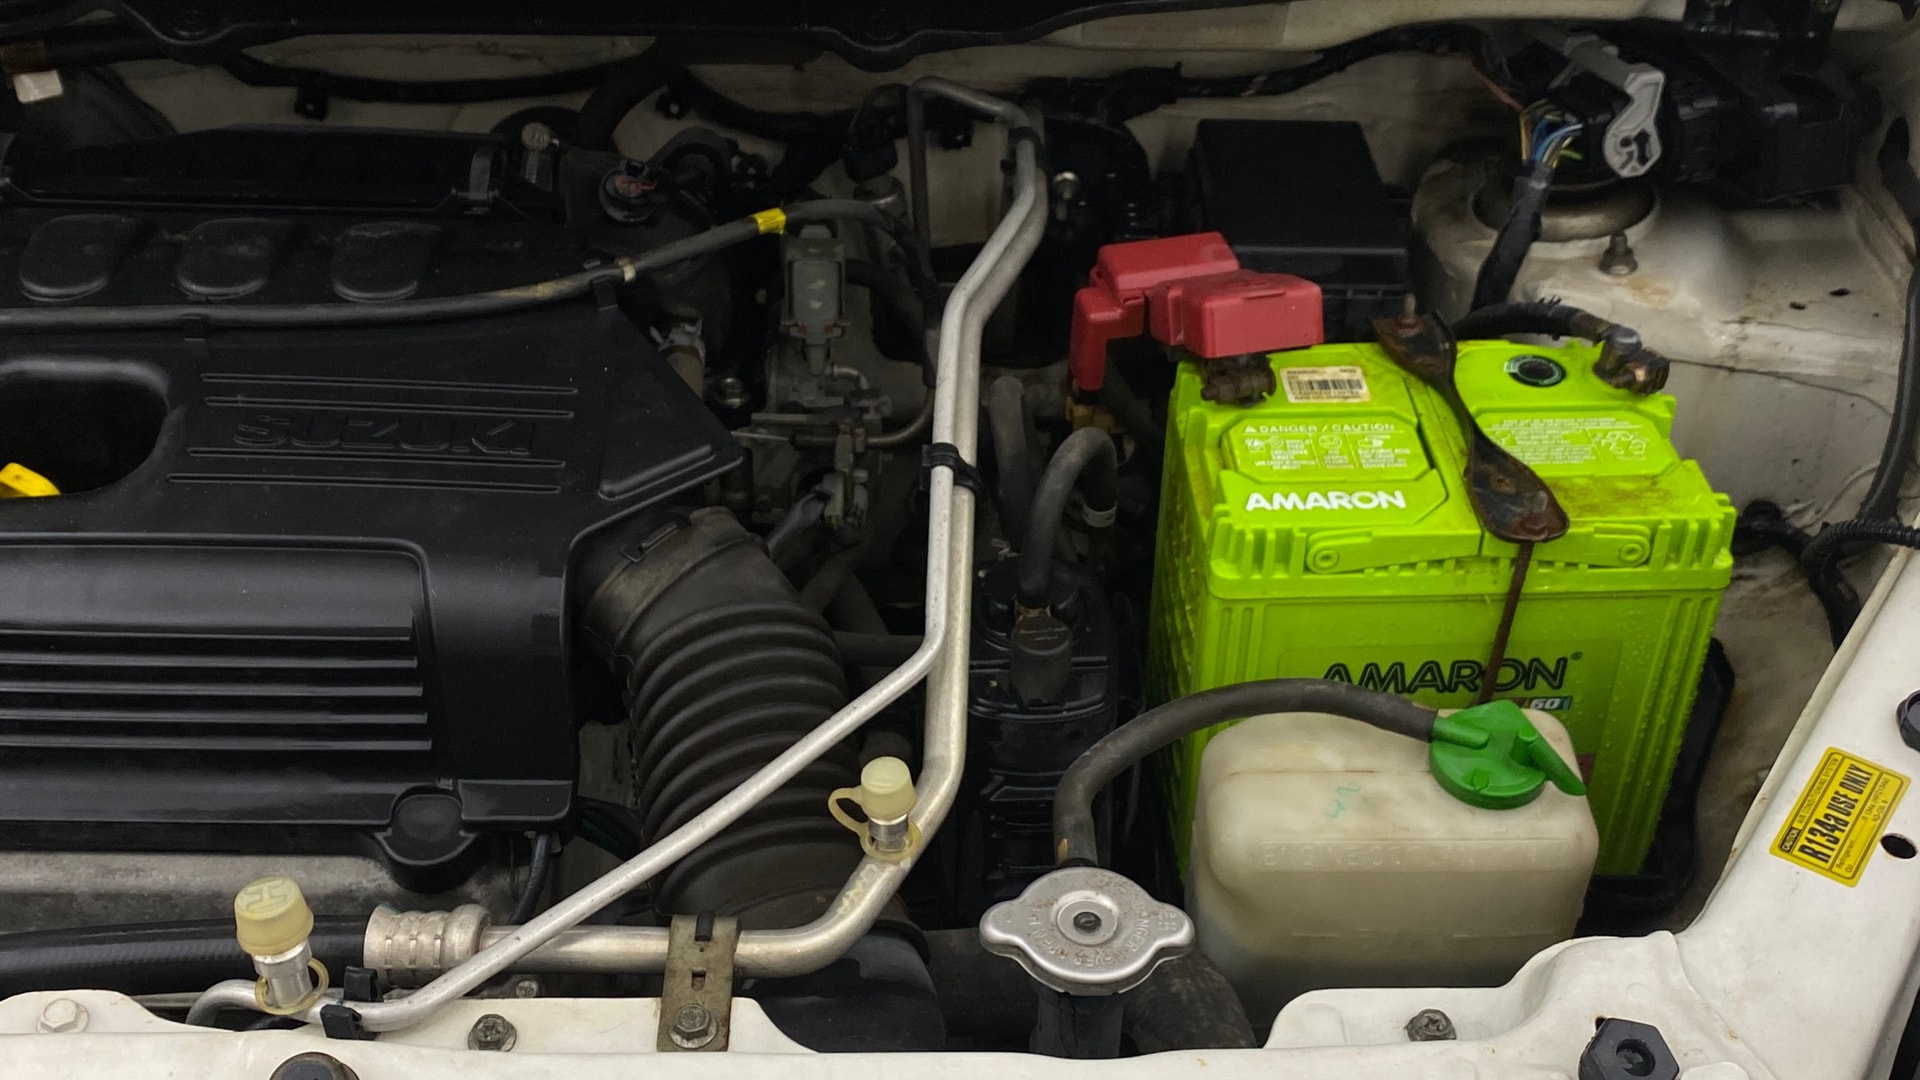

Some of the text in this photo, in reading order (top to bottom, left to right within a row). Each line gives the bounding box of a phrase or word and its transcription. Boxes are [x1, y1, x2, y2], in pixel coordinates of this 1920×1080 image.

[233, 413, 534, 455] SUZUKI
[1259, 424, 1317, 433] DANGER
[1331, 422, 1394, 432] CAUTION
[1245, 489, 1407, 512] AMARON
[1323, 656, 1569, 694] AMARON
[1797, 763, 1874, 863] R134a USE ONLY
